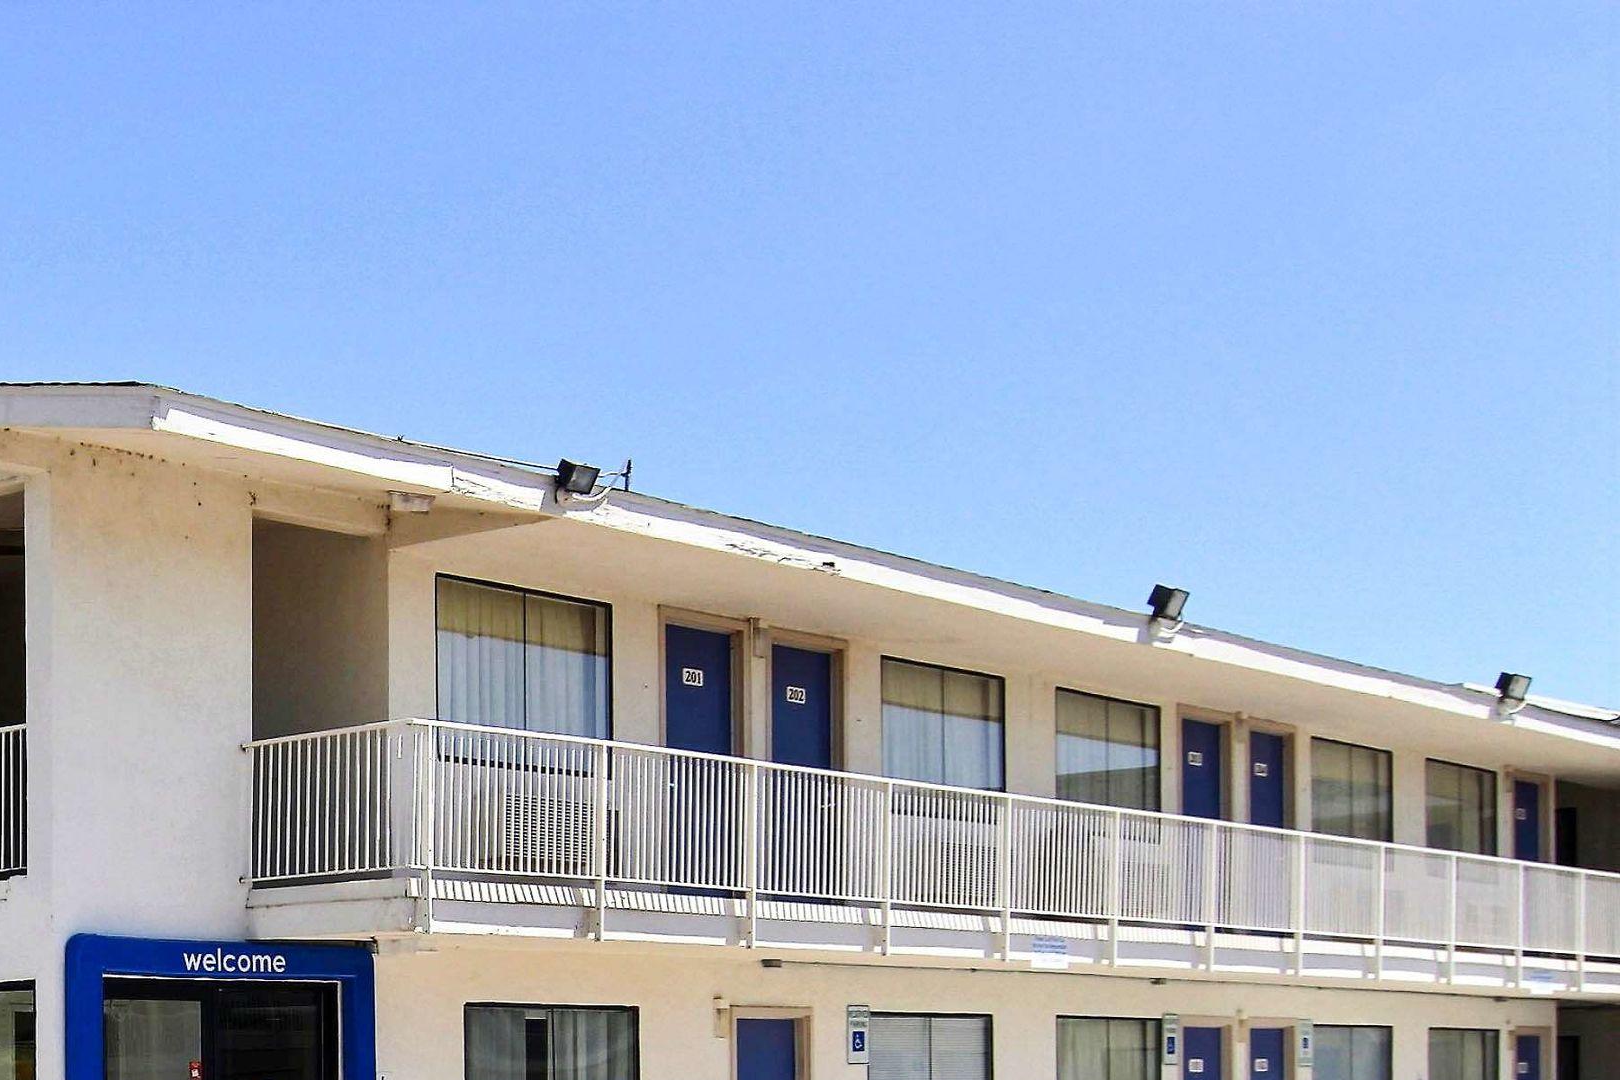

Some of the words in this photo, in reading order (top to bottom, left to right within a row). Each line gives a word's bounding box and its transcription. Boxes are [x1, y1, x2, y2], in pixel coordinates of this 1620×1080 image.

[685, 671, 701, 684] 201
[788, 688, 804, 702] 202
[183, 947, 286, 973] welcome
